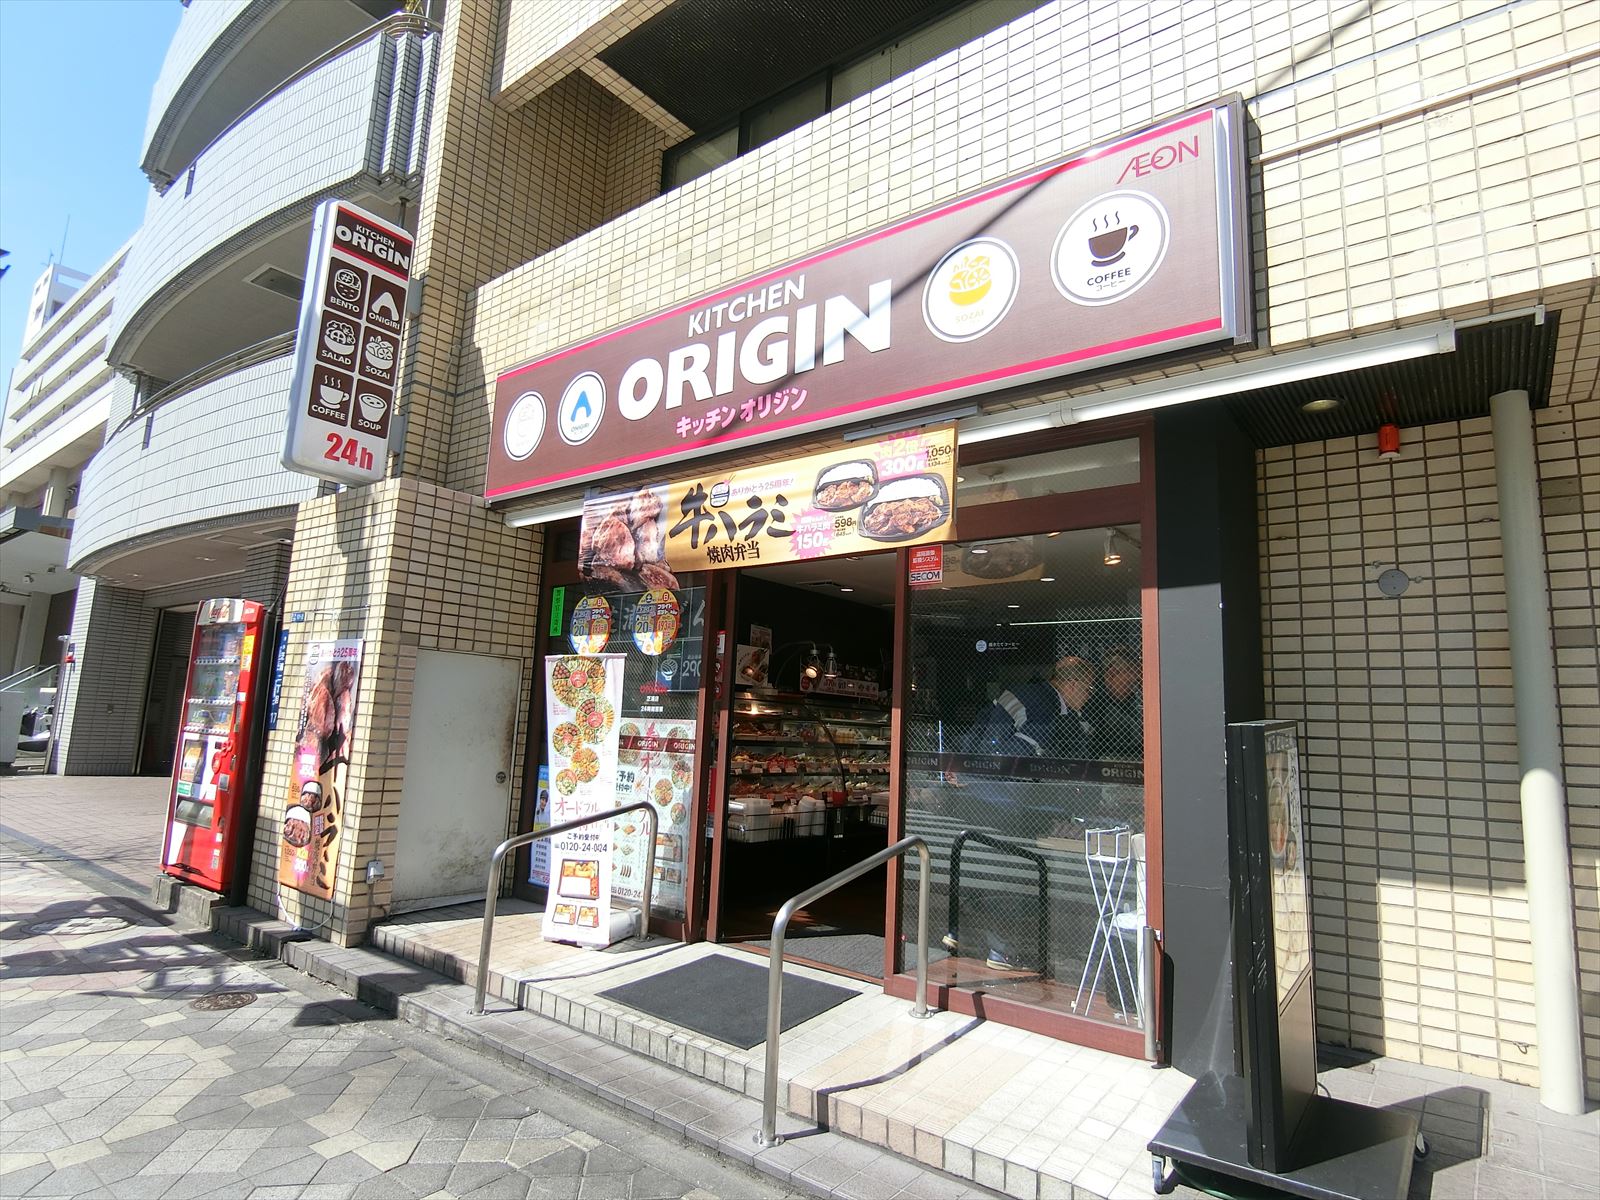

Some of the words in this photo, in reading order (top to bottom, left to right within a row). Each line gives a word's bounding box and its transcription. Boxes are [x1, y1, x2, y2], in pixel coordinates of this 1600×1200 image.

[356, 224, 395, 247] KITCHEN
[335, 225, 410, 270] ORIGIN
[1086, 267, 1131, 287] COFFEE
[330, 295, 360, 313] BENTO
[687, 274, 807, 338] KITCHEN
[368, 311, 401, 330] ONIGIRI
[321, 349, 352, 366] SALAD
[617, 279, 892, 421] ORIGIN
[365, 365, 391, 380] SOZAI
[311, 404, 346, 421] COFFEE
[676, 405, 737, 440] キッチン
[739, 387, 808, 423] オリジン
[358, 418, 382, 431] SOUP
[324, 432, 374, 471] 24h
[669, 482, 796, 549] 牛ハラミ
[707, 541, 760, 564] 焼肉弁当
[910, 571, 940, 582] SECOM
[616, 770, 635, 783] 予約
[1101, 766, 1145, 780] ORIGIN
